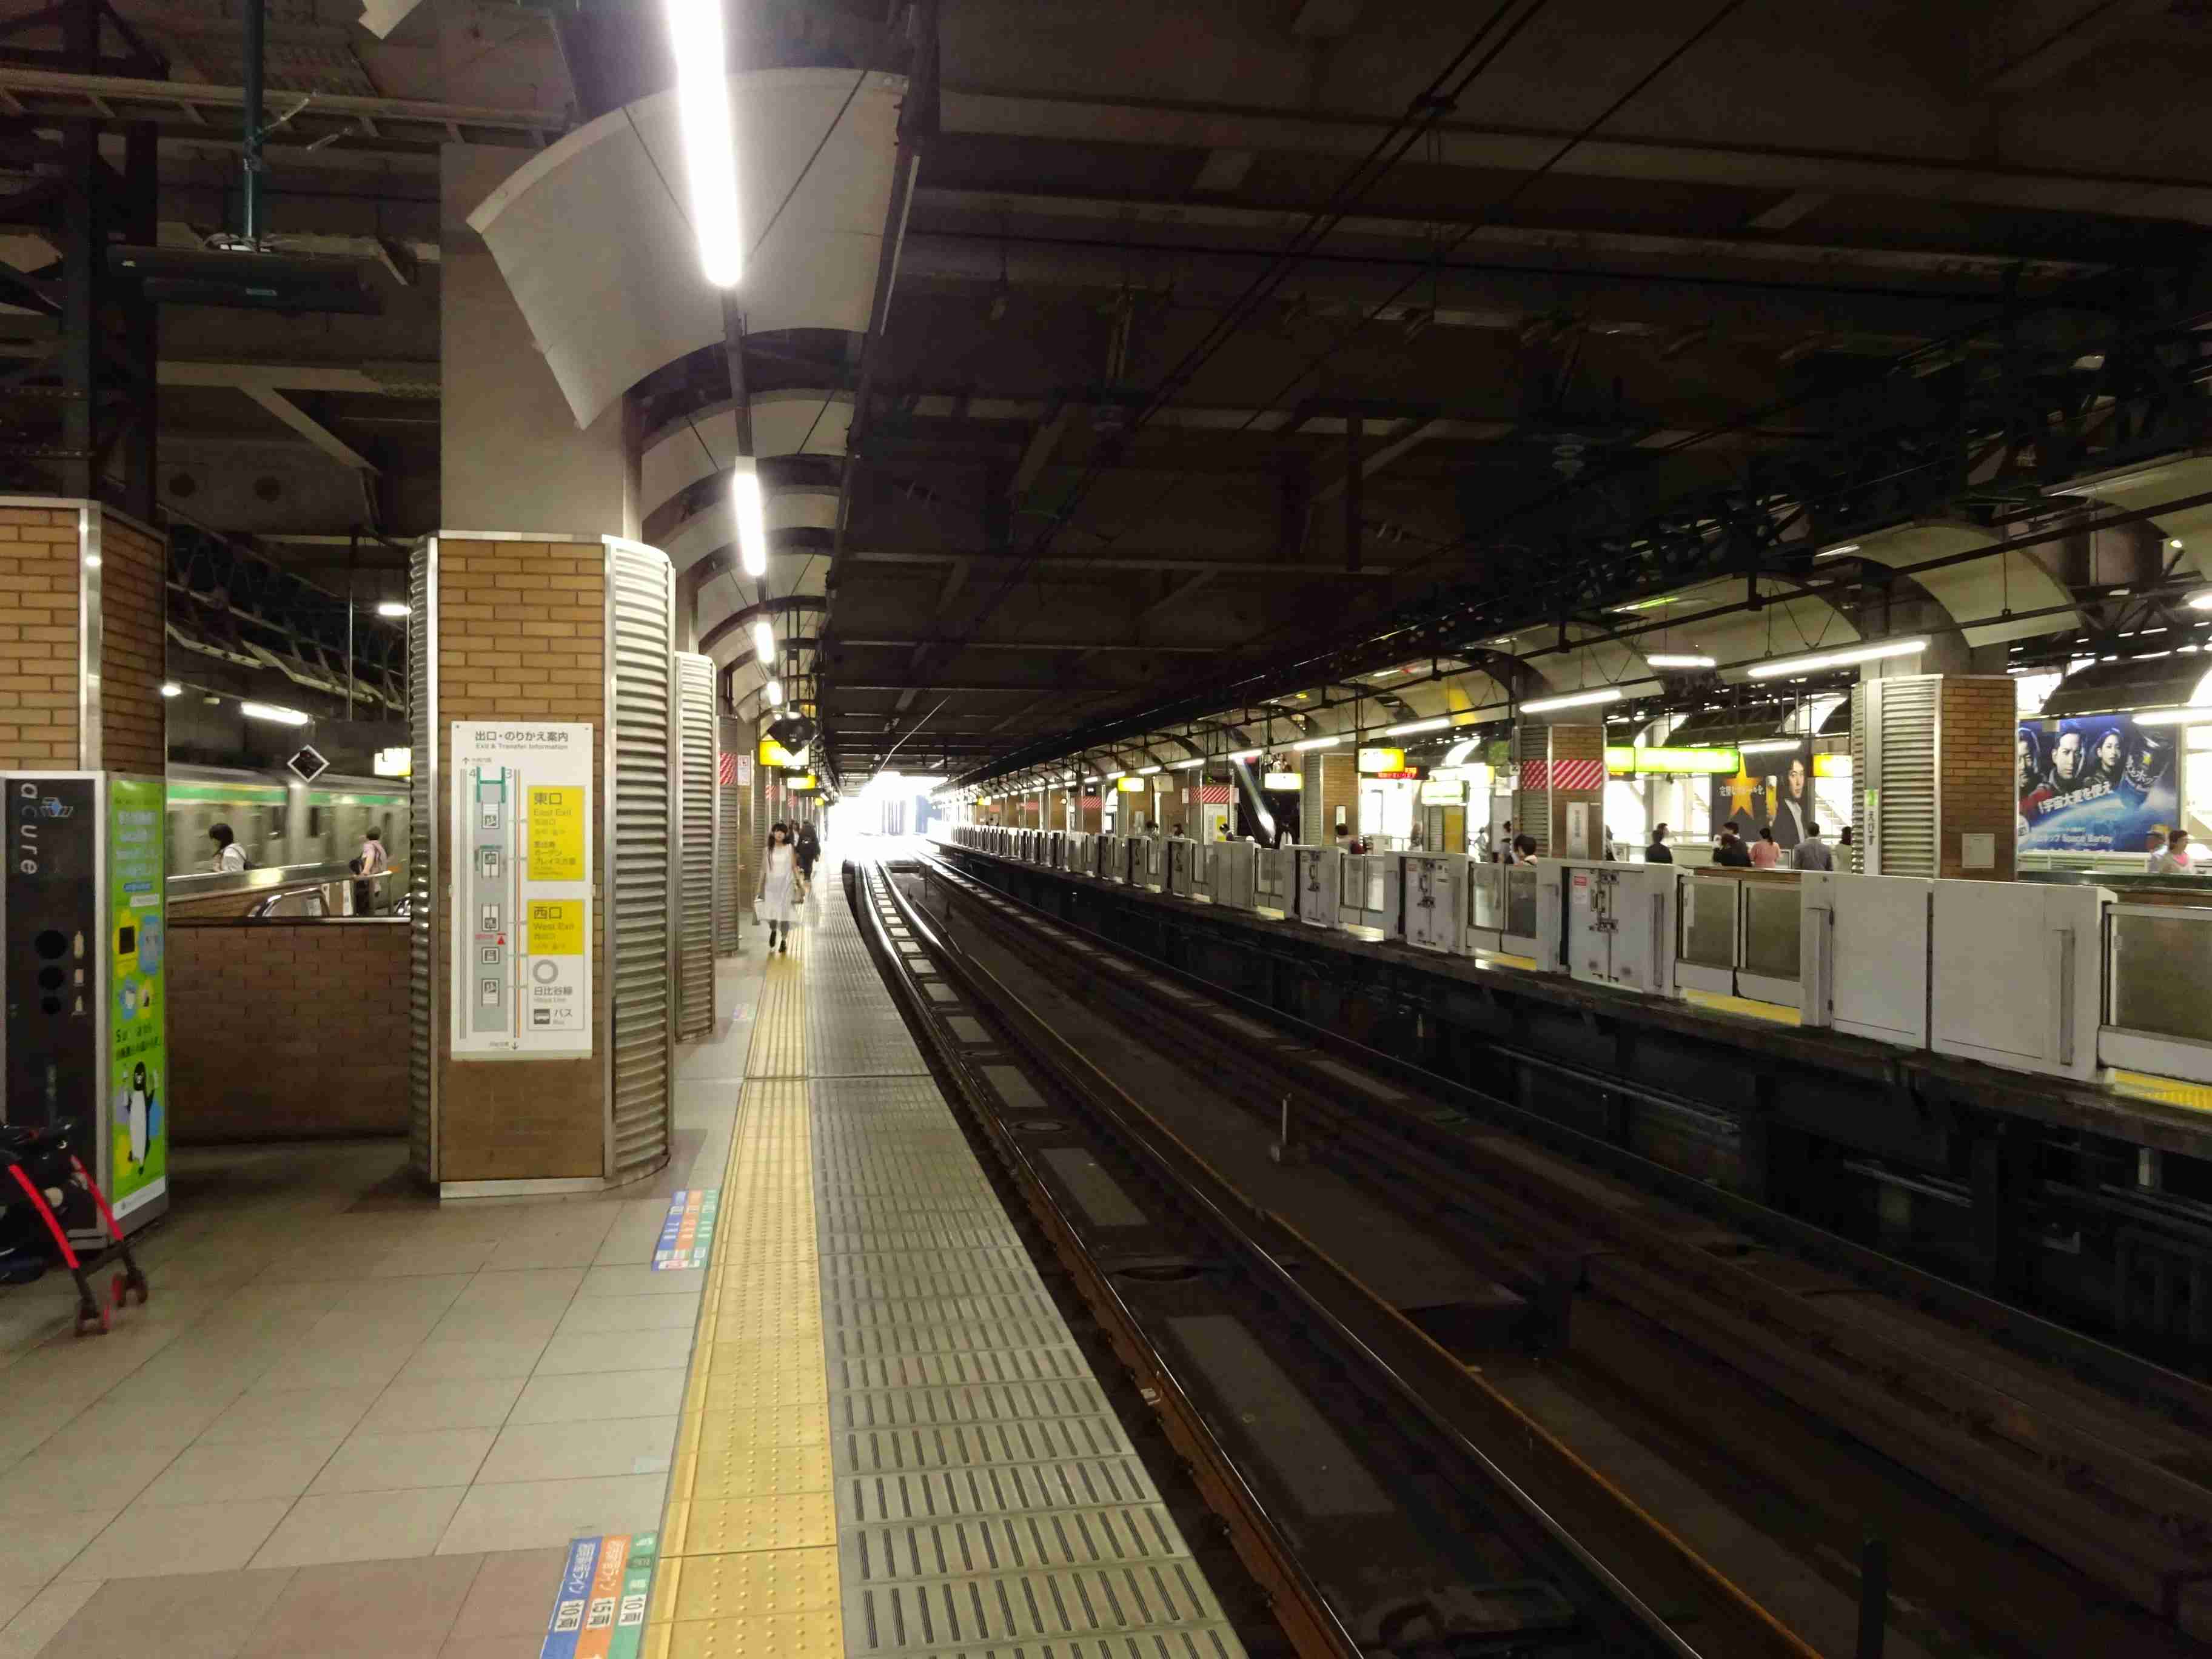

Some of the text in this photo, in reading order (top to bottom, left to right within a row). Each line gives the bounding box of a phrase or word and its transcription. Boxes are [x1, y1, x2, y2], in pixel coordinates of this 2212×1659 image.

[475, 731, 568, 742] 出口・のりかえ案内
[469, 769, 476, 778] 4
[505, 769, 512, 778] 3
[534, 793, 563, 806] 東口
[19, 782, 39, 875] acure
[534, 907, 562, 919] 西口
[554, 1008, 573, 1017] バス
